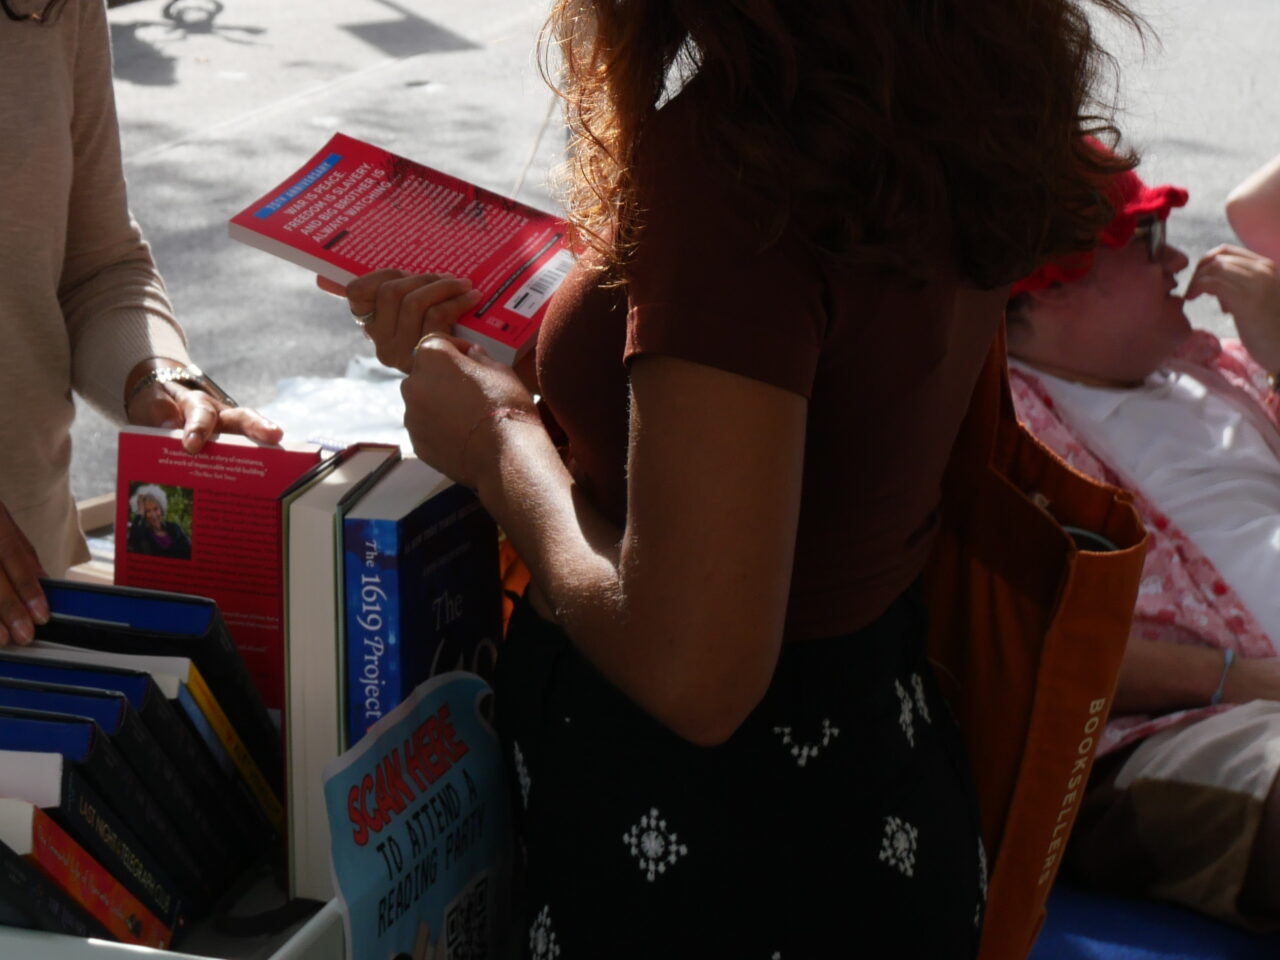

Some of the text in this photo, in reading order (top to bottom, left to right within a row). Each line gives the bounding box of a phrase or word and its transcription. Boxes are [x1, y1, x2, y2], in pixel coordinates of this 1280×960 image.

[282, 200, 327, 232] FREEDOM
[323, 193, 337, 203] IS
[283, 199, 307, 215] WAR
[305, 191, 318, 201] IS
[300, 168, 386, 236] AND BIG BROTHER IS
[311, 214, 350, 244] ALWAYS
[359, 540, 387, 719] The 1619 Project
[432, 588, 464, 632] The
[347, 748, 416, 847] SCAN
[404, 703, 470, 793] HERE
[1037, 696, 1106, 887] BOOKSELLERS
[376, 768, 478, 881] TO ATTEND A
[378, 803, 487, 938] READING PARTY
